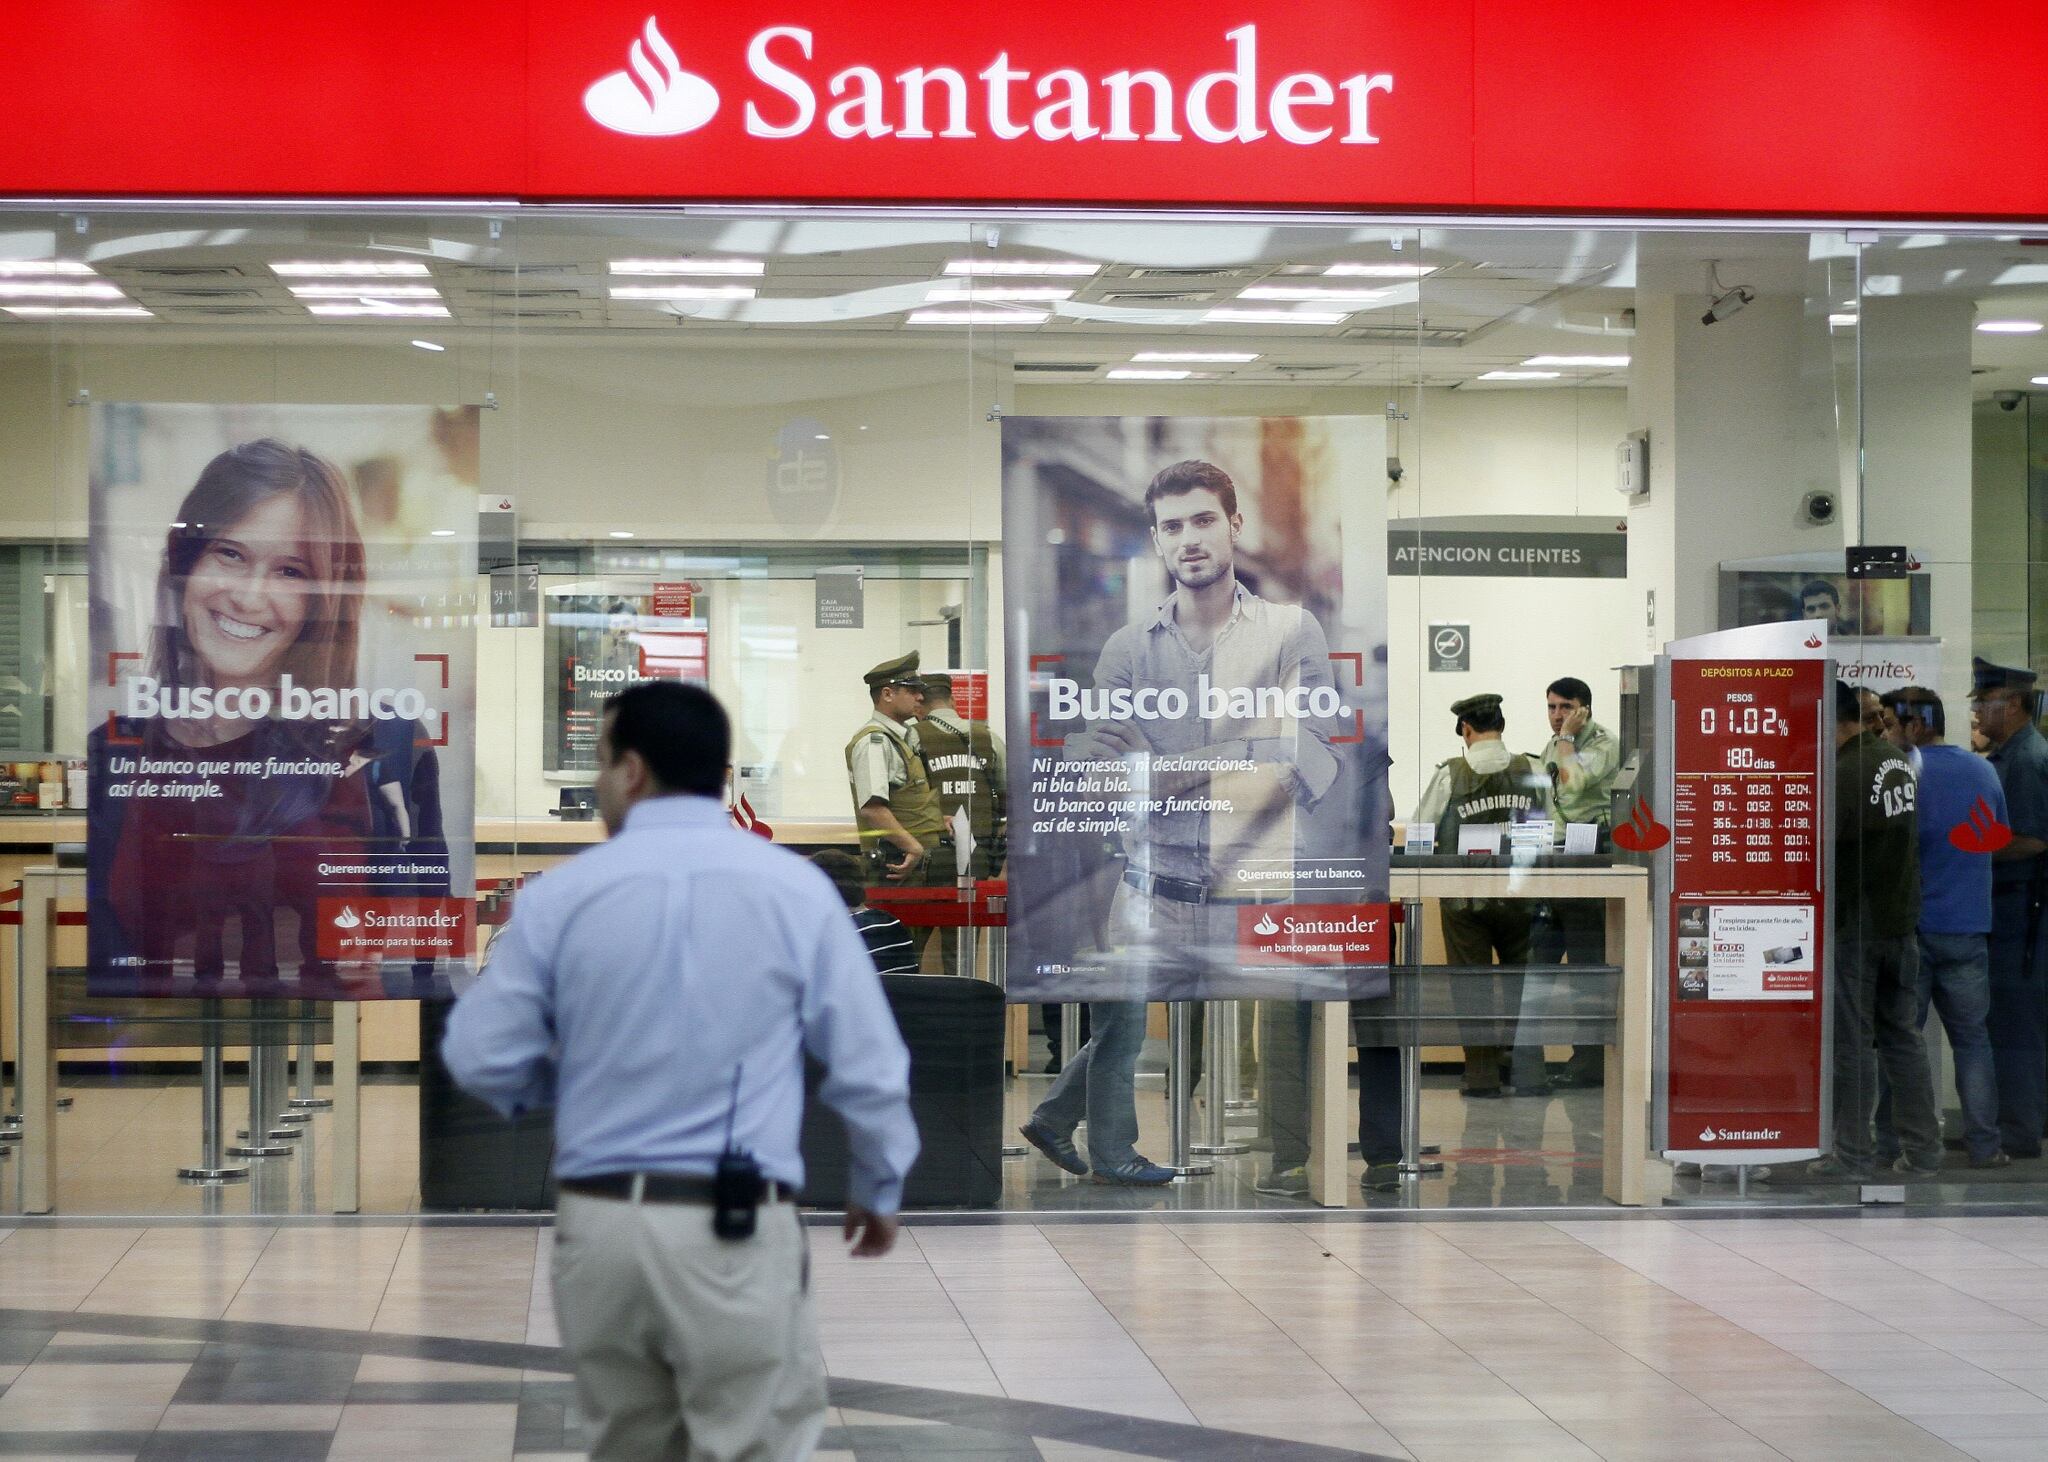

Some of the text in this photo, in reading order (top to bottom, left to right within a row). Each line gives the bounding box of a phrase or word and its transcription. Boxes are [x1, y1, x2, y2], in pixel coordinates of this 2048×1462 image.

[745, 24, 1394, 145] Santander
[1395, 547, 1581, 564] ATENCION CLIENTES
[528, 576, 537, 590] 2
[857, 575, 863, 590] 1
[574, 665, 625, 682] Busco
[1701, 666, 1794, 678] DEPÓSITOS A PLAZO
[1836, 660, 1916, 681] trámites,
[127, 673, 438, 721] Busco banco.
[1049, 673, 1352, 721] Busco banco.
[1727, 693, 1753, 703] PESOS
[1032, 756, 1258, 777] Ni promesas, ni declaraciones,
[1727, 747, 1776, 770] 180 días
[109, 757, 346, 781] Un banco que me funcione,
[108, 780, 224, 802] así de simple.
[942, 781, 953, 795] DE
[1032, 777, 1132, 794] ni bla bla bla.
[1033, 796, 1234, 818] Un banco que me funcione,
[1457, 794, 1532, 820] CARABINEROS
[1032, 817, 1131, 836] así de simple.
[318, 863, 449, 876] Queremos ser tu banco.
[1237, 867, 1366, 882] Queremos ser tu banco.
[364, 909, 460, 928] Santander
[1283, 915, 1376, 935] Santander
[340, 937, 453, 949] un banco para tus ideas
[1260, 942, 1370, 955] un banco para tus ideas
[1715, 944, 1744, 952] TODO
[1718, 1128, 1781, 1141] Santander
